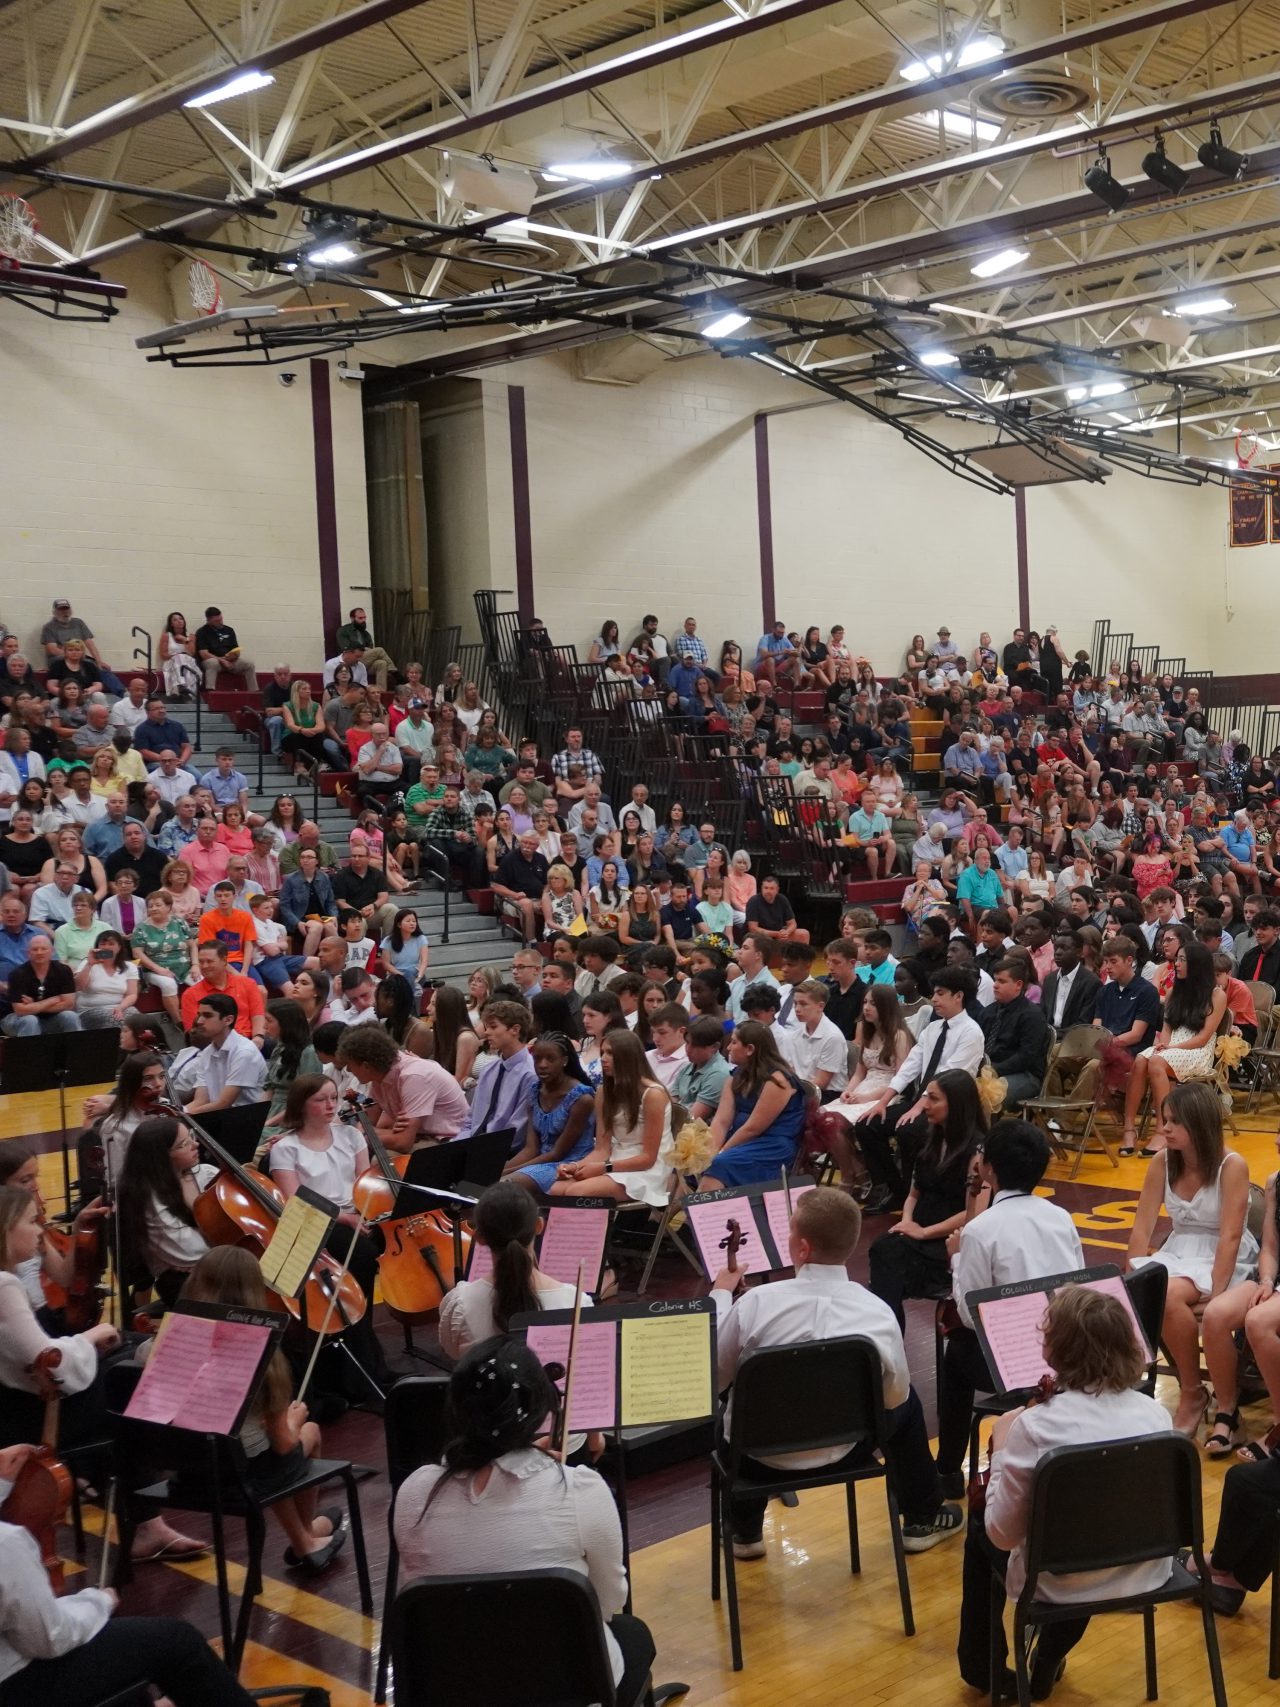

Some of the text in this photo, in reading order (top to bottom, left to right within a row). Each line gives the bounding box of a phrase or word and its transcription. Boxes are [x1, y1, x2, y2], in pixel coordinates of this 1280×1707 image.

[575, 1197, 604, 1208] CCHS
[687, 1193, 712, 1203] CCHS
[649, 1300, 704, 1313] Colonie HS
